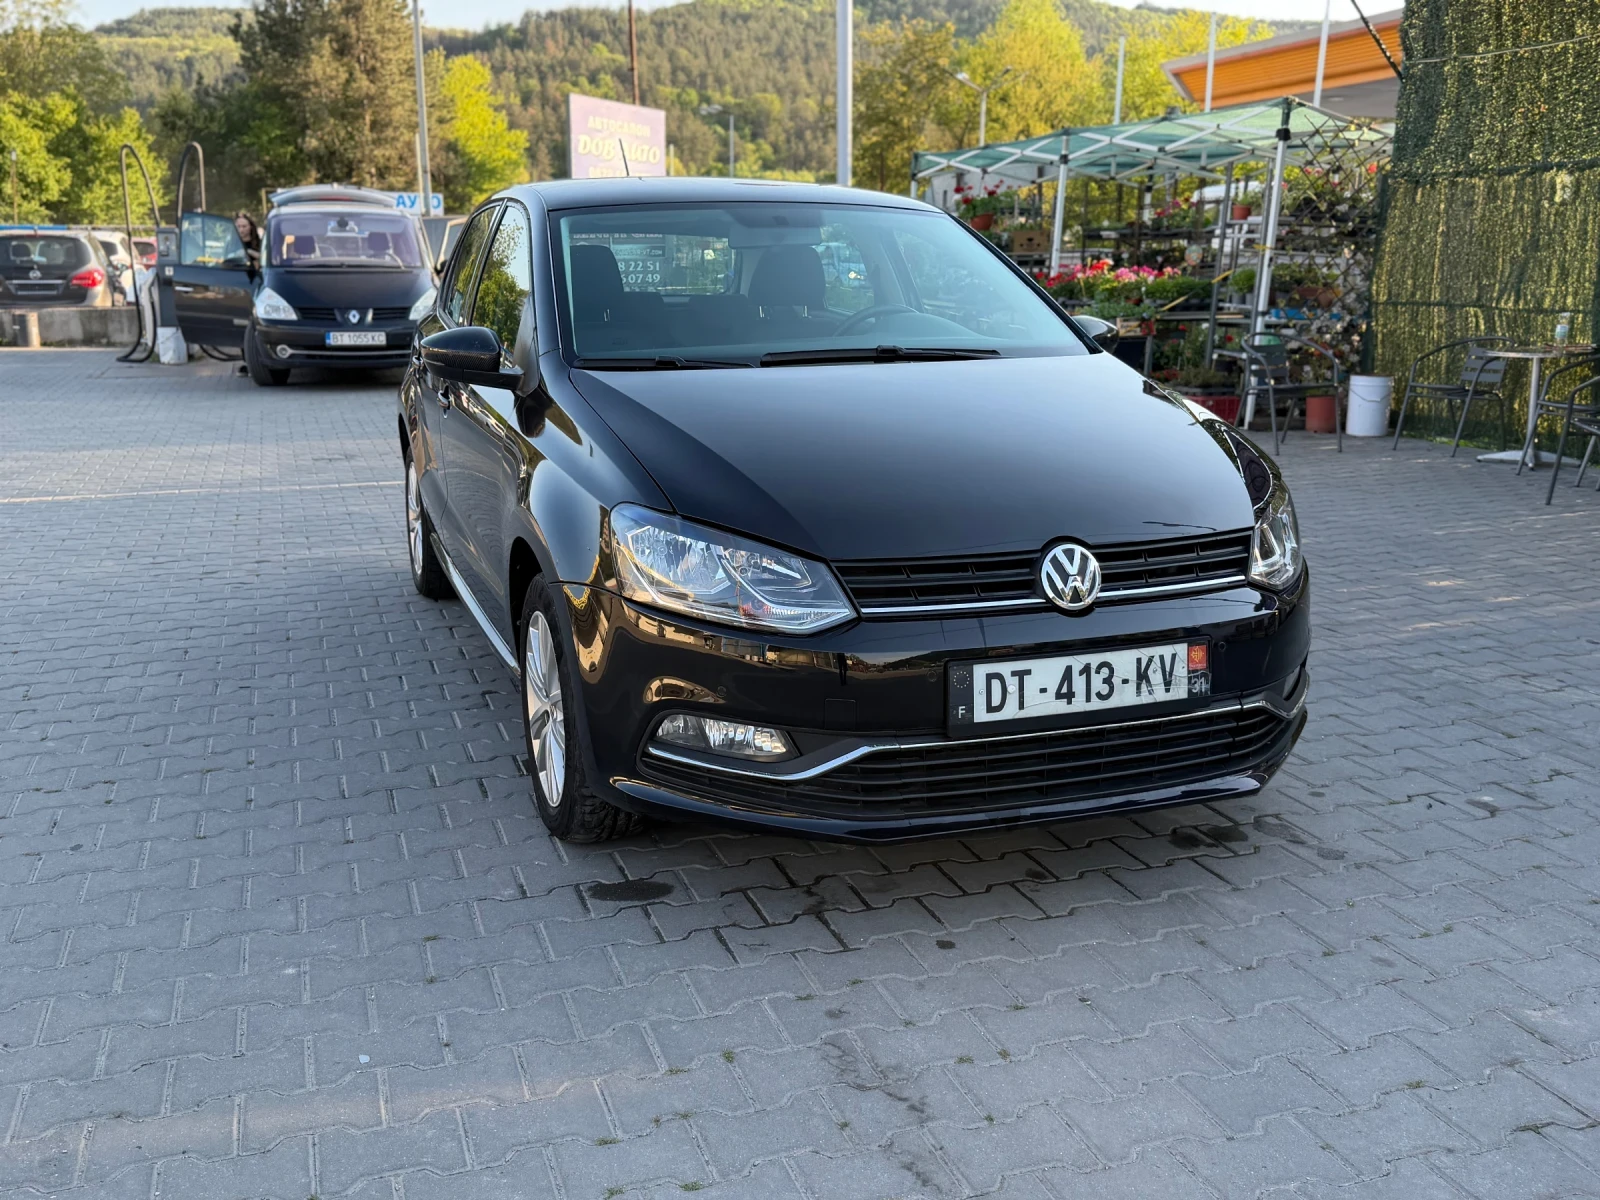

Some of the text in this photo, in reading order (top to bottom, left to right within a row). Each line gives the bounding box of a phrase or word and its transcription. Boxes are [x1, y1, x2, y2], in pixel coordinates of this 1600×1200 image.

[629, 261, 644, 271] 22
[647, 261, 660, 271] 51
[628, 274, 643, 284] 07
[645, 274, 661, 284] 49
[348, 334, 370, 343] 1055
[1191, 676, 1206, 693] 31
[958, 706, 966, 719] F
